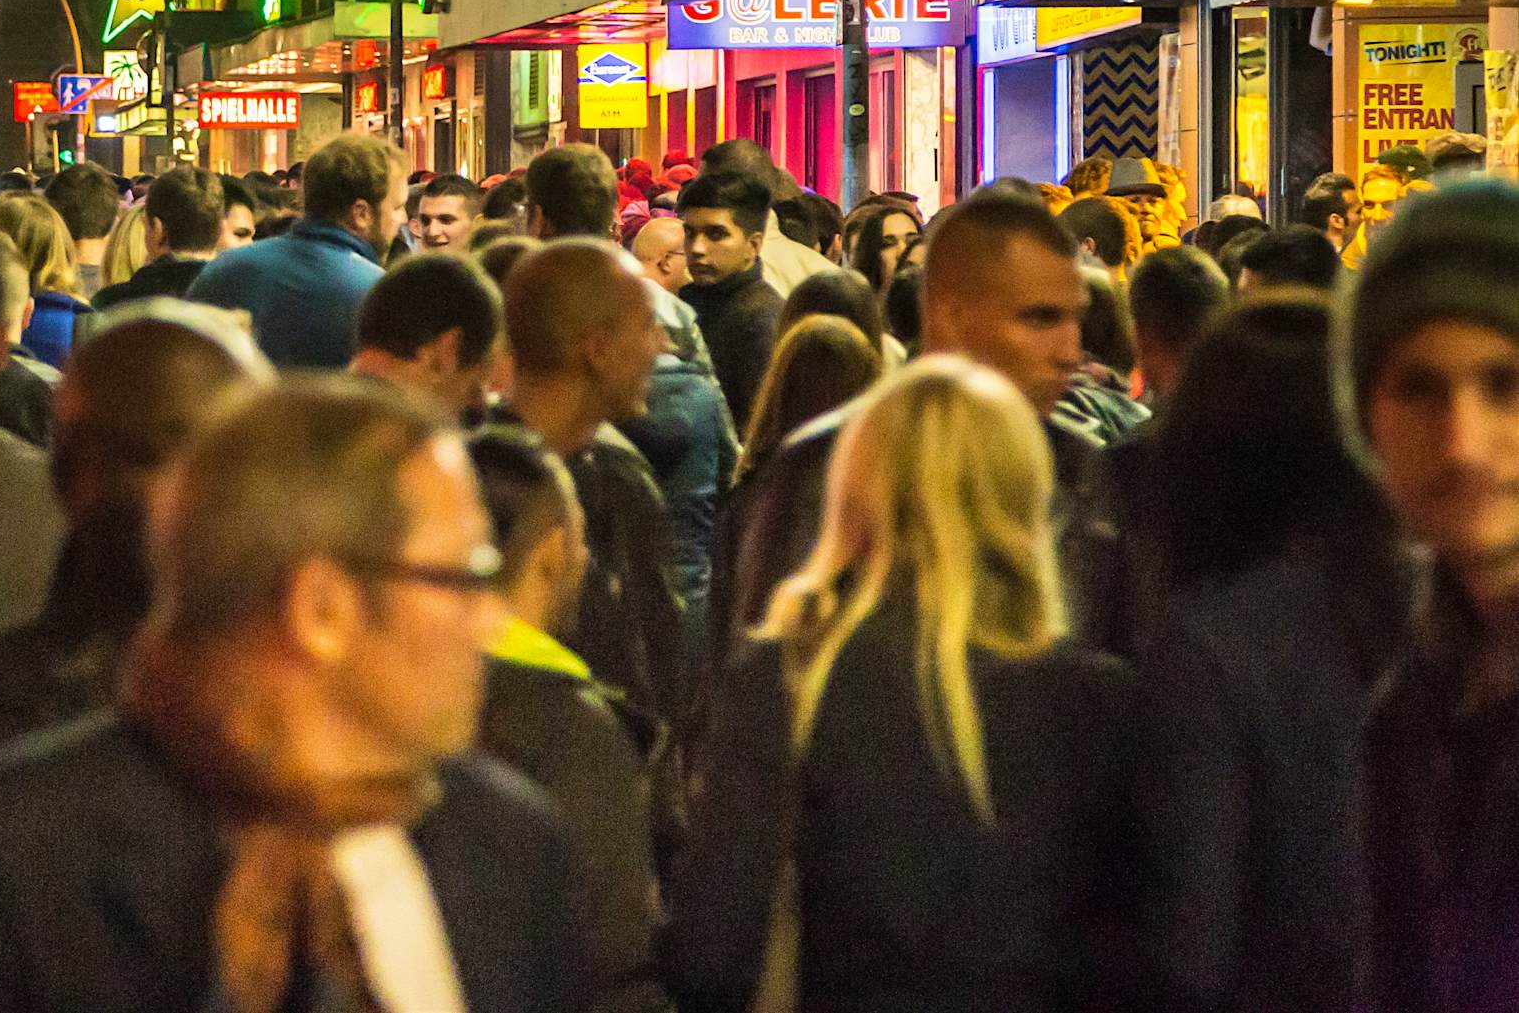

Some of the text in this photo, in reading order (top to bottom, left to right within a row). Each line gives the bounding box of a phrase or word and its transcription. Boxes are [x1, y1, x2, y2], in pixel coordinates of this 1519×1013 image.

[729, 27, 901, 43] BAR & NIGH LUB
[1365, 41, 1446, 62] TONIGHT!
[1364, 84, 1424, 106] FREE
[201, 97, 297, 123] SPIELHALLE
[1364, 108, 1455, 130] ENTRAN
